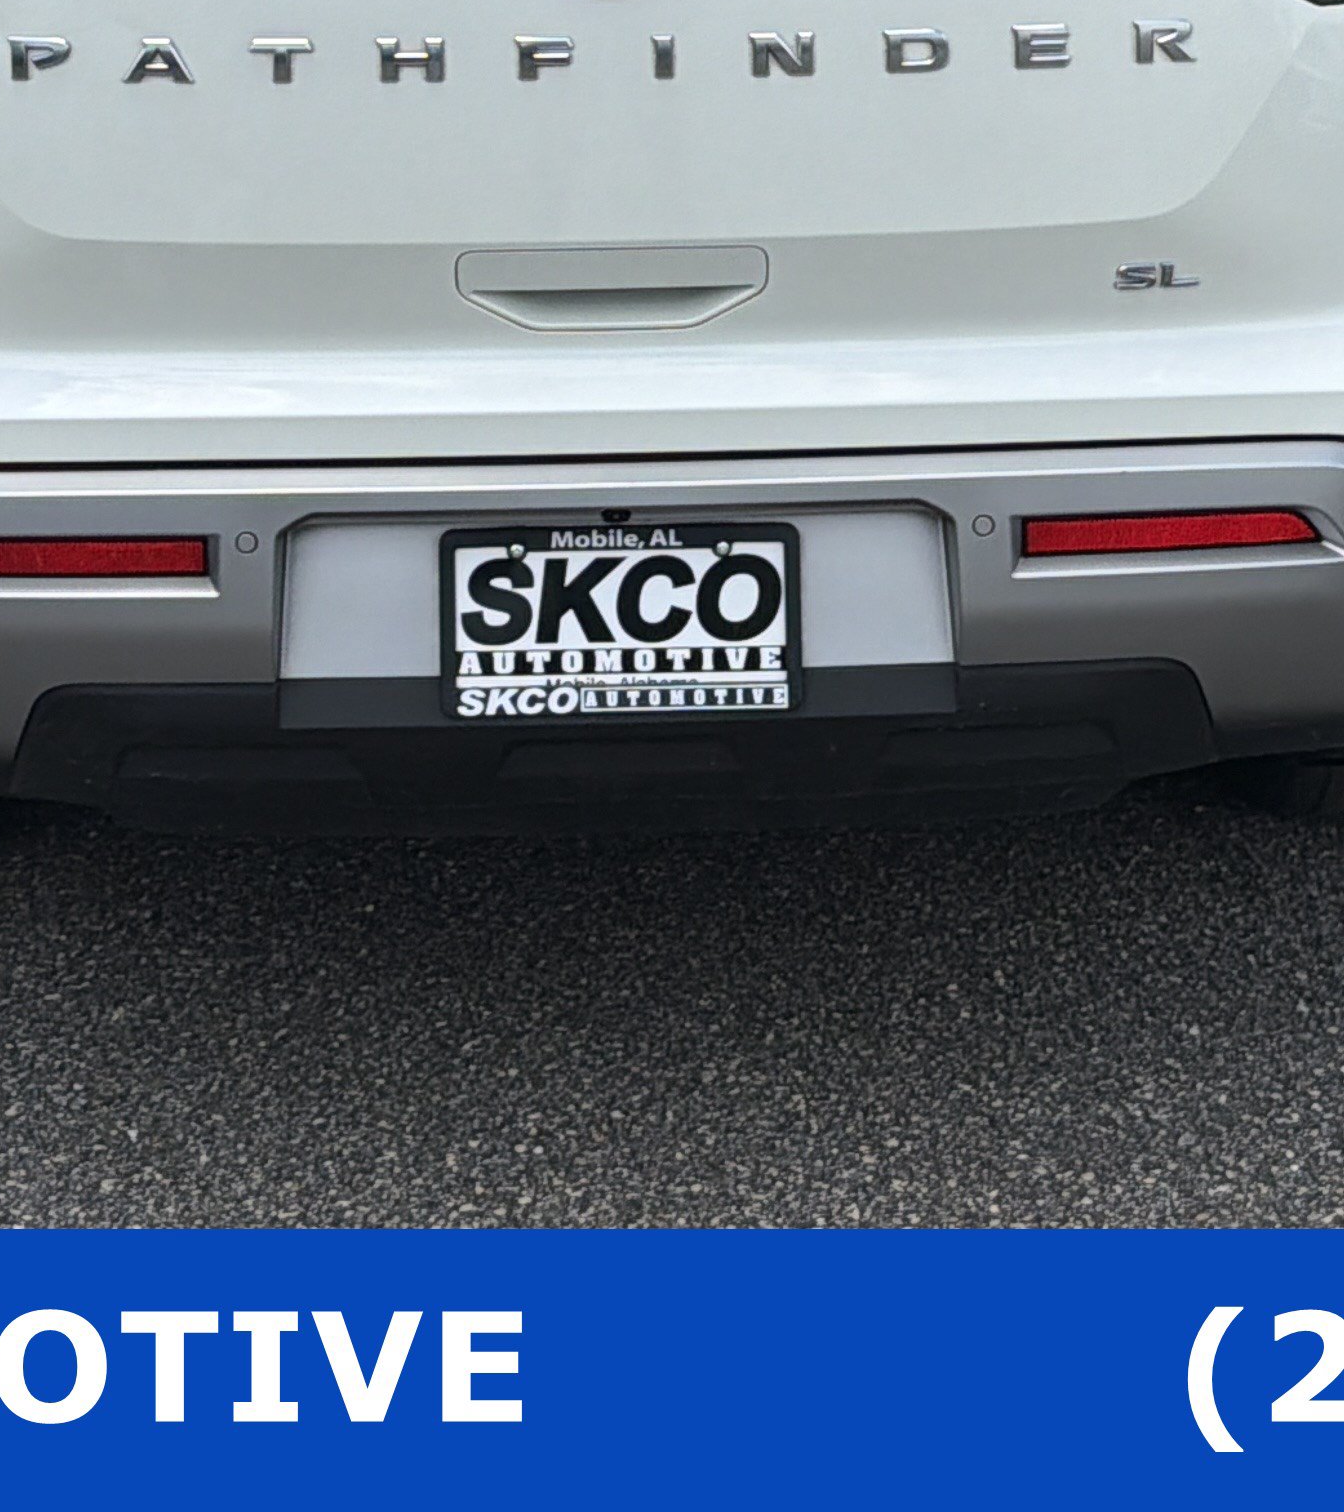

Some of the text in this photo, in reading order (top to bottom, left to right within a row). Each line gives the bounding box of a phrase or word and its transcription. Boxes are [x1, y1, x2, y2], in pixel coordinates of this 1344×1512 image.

[7, 19, 1198, 82] PATHFINDER
[1114, 262, 1199, 290] SL
[551, 528, 683, 549] Mobile, AL
[461, 554, 782, 645] SKCO
[459, 647, 783, 675] AUTOMOTIVE
[457, 687, 786, 717] SKCO AUTOMOTIVE
